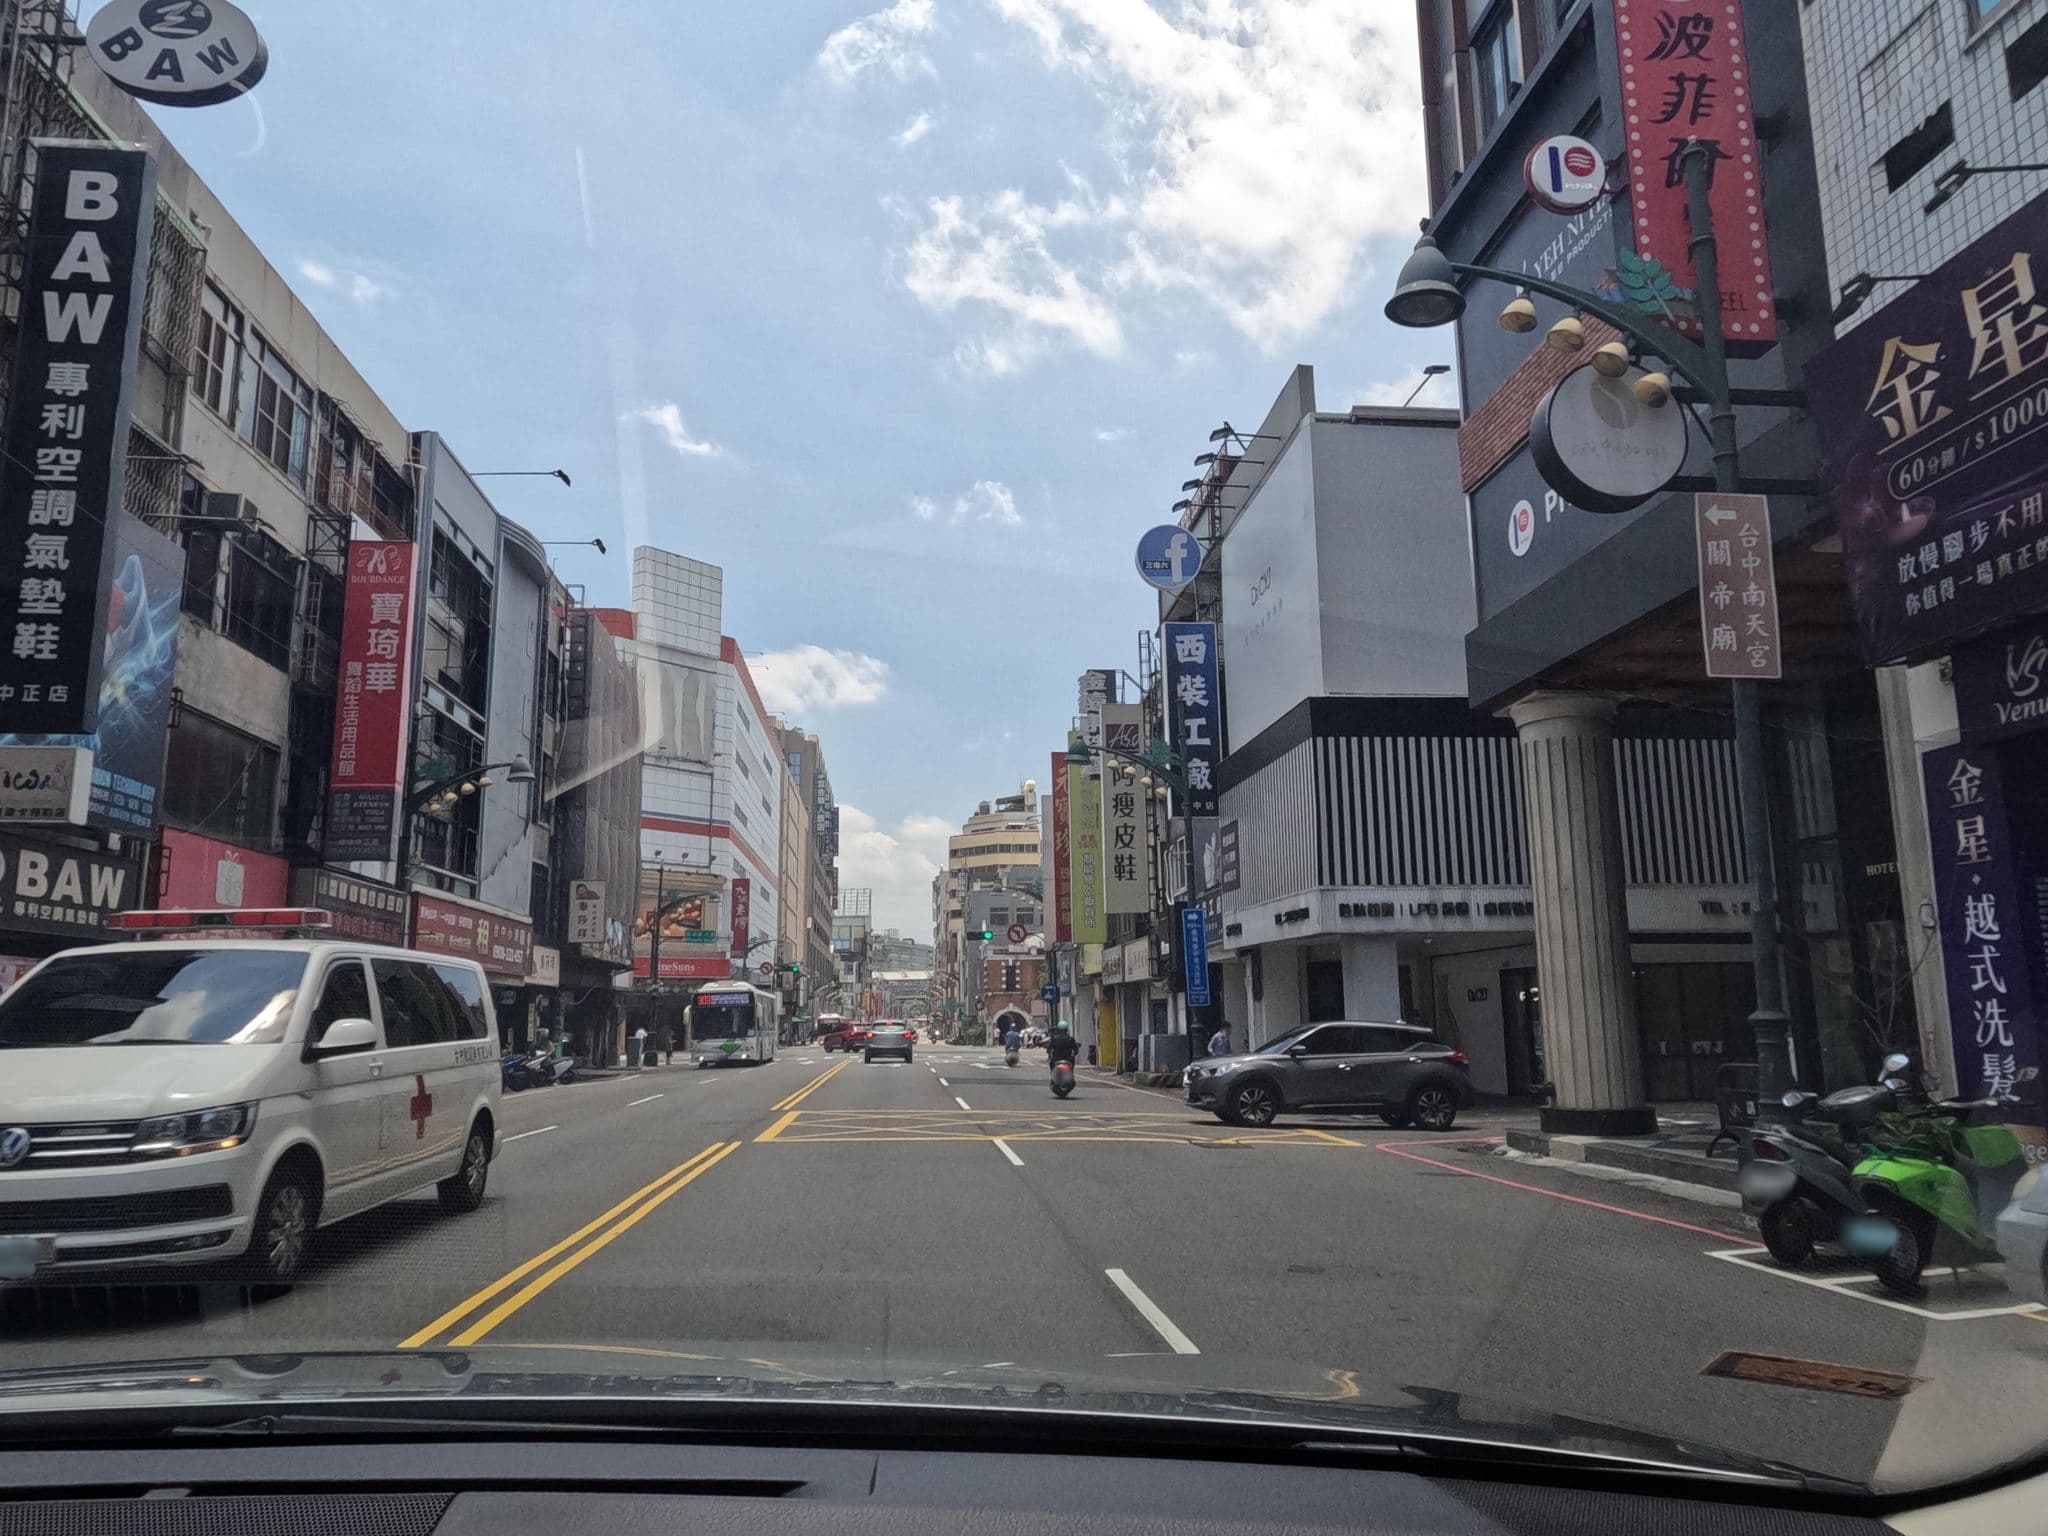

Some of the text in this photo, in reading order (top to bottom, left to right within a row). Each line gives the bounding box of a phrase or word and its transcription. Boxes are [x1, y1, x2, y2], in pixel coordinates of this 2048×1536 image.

[99, 27, 239, 83] BAW
[1865, 252, 2048, 456] 金星
[13, 170, 119, 660] BAW 專利空調氣墊鞋
[1707, 539, 1738, 652] 關帝廟
[1897, 491, 2043, 583] 放慢腳步不用
[364, 592, 405, 694] 寶琦華
[1737, 523, 1771, 669] 台中南天宮
[1174, 633, 1214, 791] 西裝工廠
[16, 849, 126, 910] BAW
[1111, 760, 1139, 882] 阿瘦皮鞋
